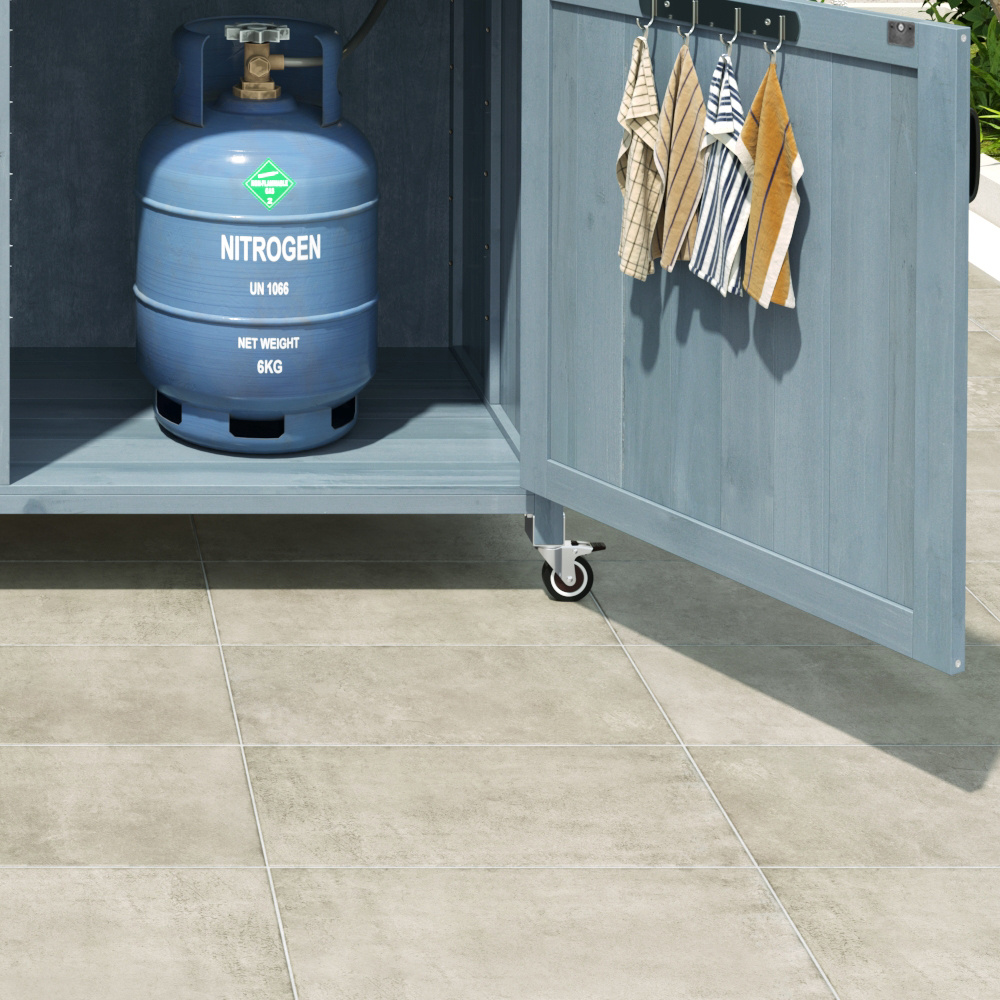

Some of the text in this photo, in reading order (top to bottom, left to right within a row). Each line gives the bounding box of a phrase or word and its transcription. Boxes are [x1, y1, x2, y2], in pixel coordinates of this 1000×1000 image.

[220, 233, 321, 263] NITROGEN
[249, 281, 290, 296] UN 1066
[237, 336, 300, 350] NET WEIGHT
[256, 359, 283, 375] 6KG
